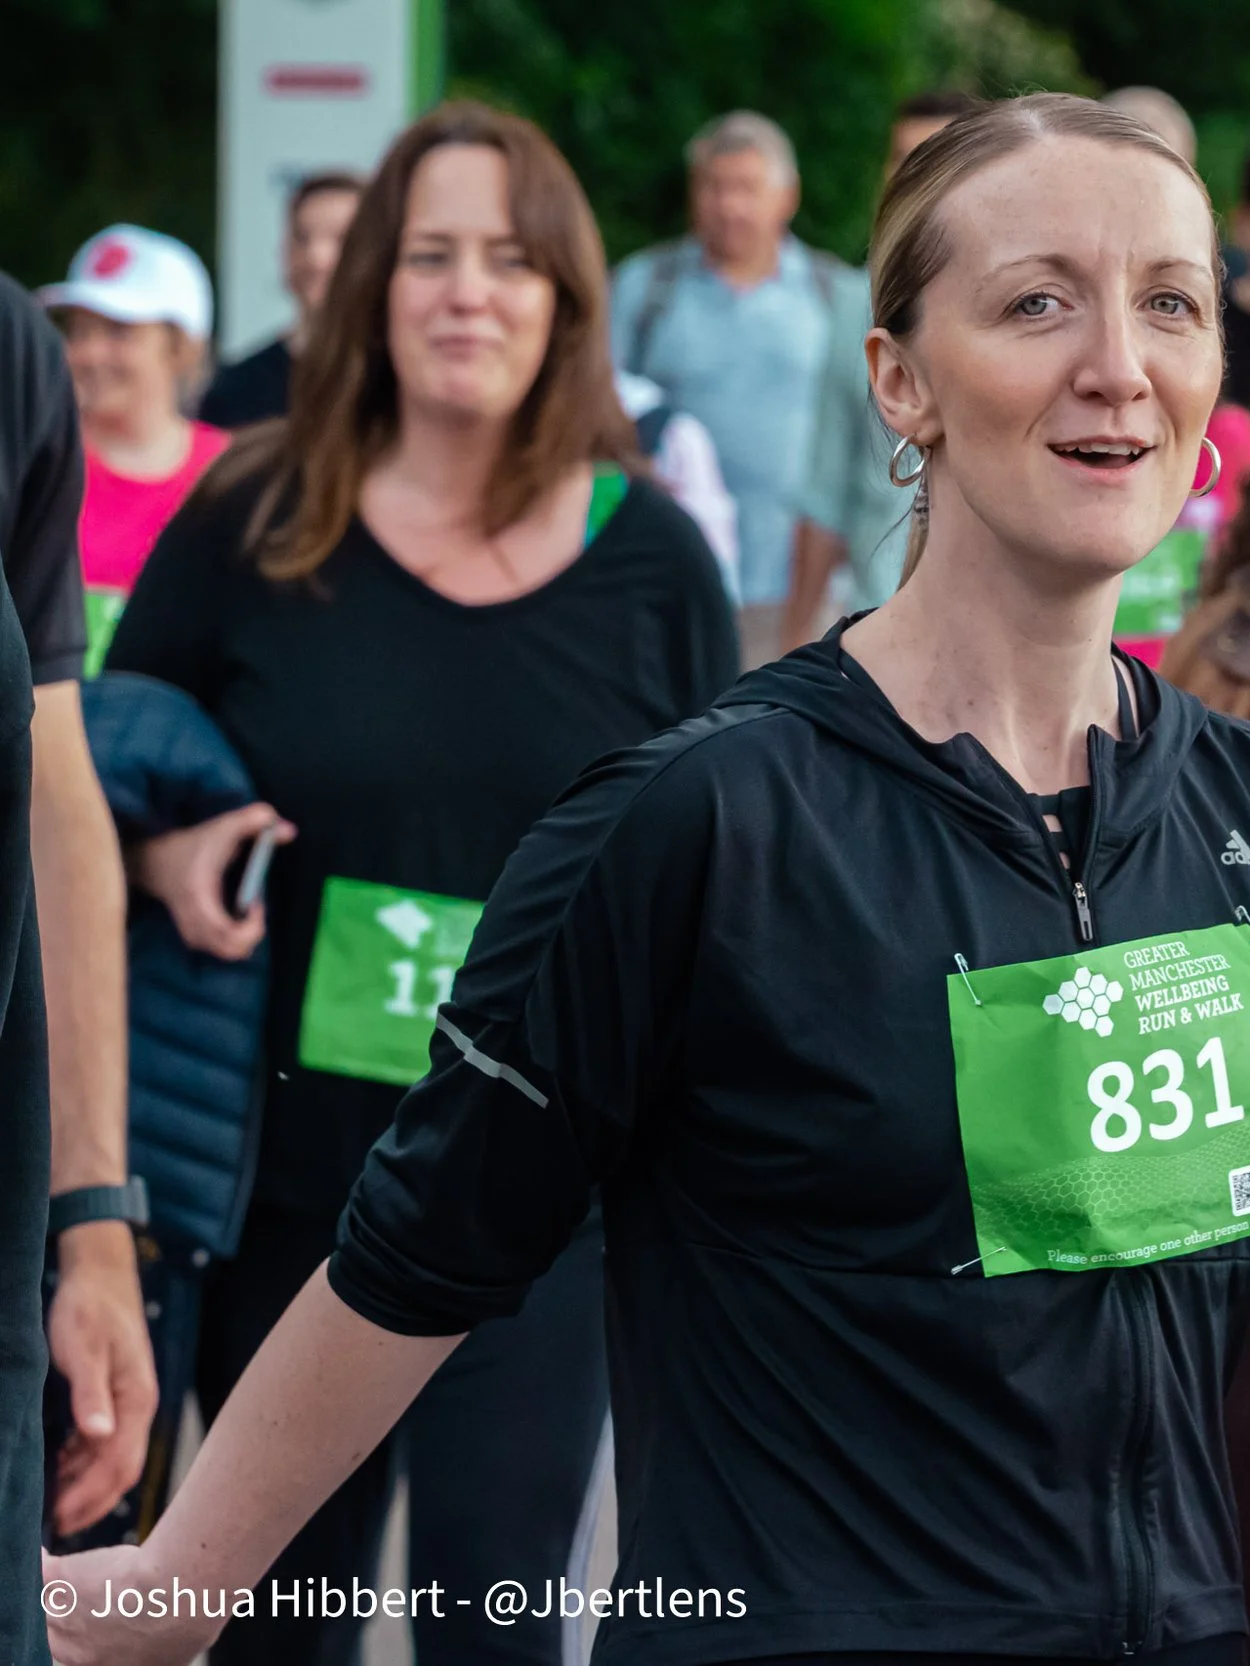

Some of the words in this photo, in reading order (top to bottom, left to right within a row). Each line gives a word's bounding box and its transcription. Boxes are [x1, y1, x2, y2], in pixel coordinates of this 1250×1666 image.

[1123, 941, 1190, 969] GREATER
[1129, 954, 1231, 991] MANCHESTER
[1135, 975, 1230, 1012] WELLBEING
[1138, 1009, 1176, 1035] RUN
[1180, 1007, 1192, 1024] &
[1194, 993, 1244, 1020] WALK
[1087, 1036, 1245, 1153] 831
[1047, 1249, 1088, 1265] Please
[1091, 1243, 1158, 1264] encourage
[1160, 1238, 1182, 1251] one
[1184, 1230, 1213, 1246] other
[1214, 1221, 1250, 1241] person
